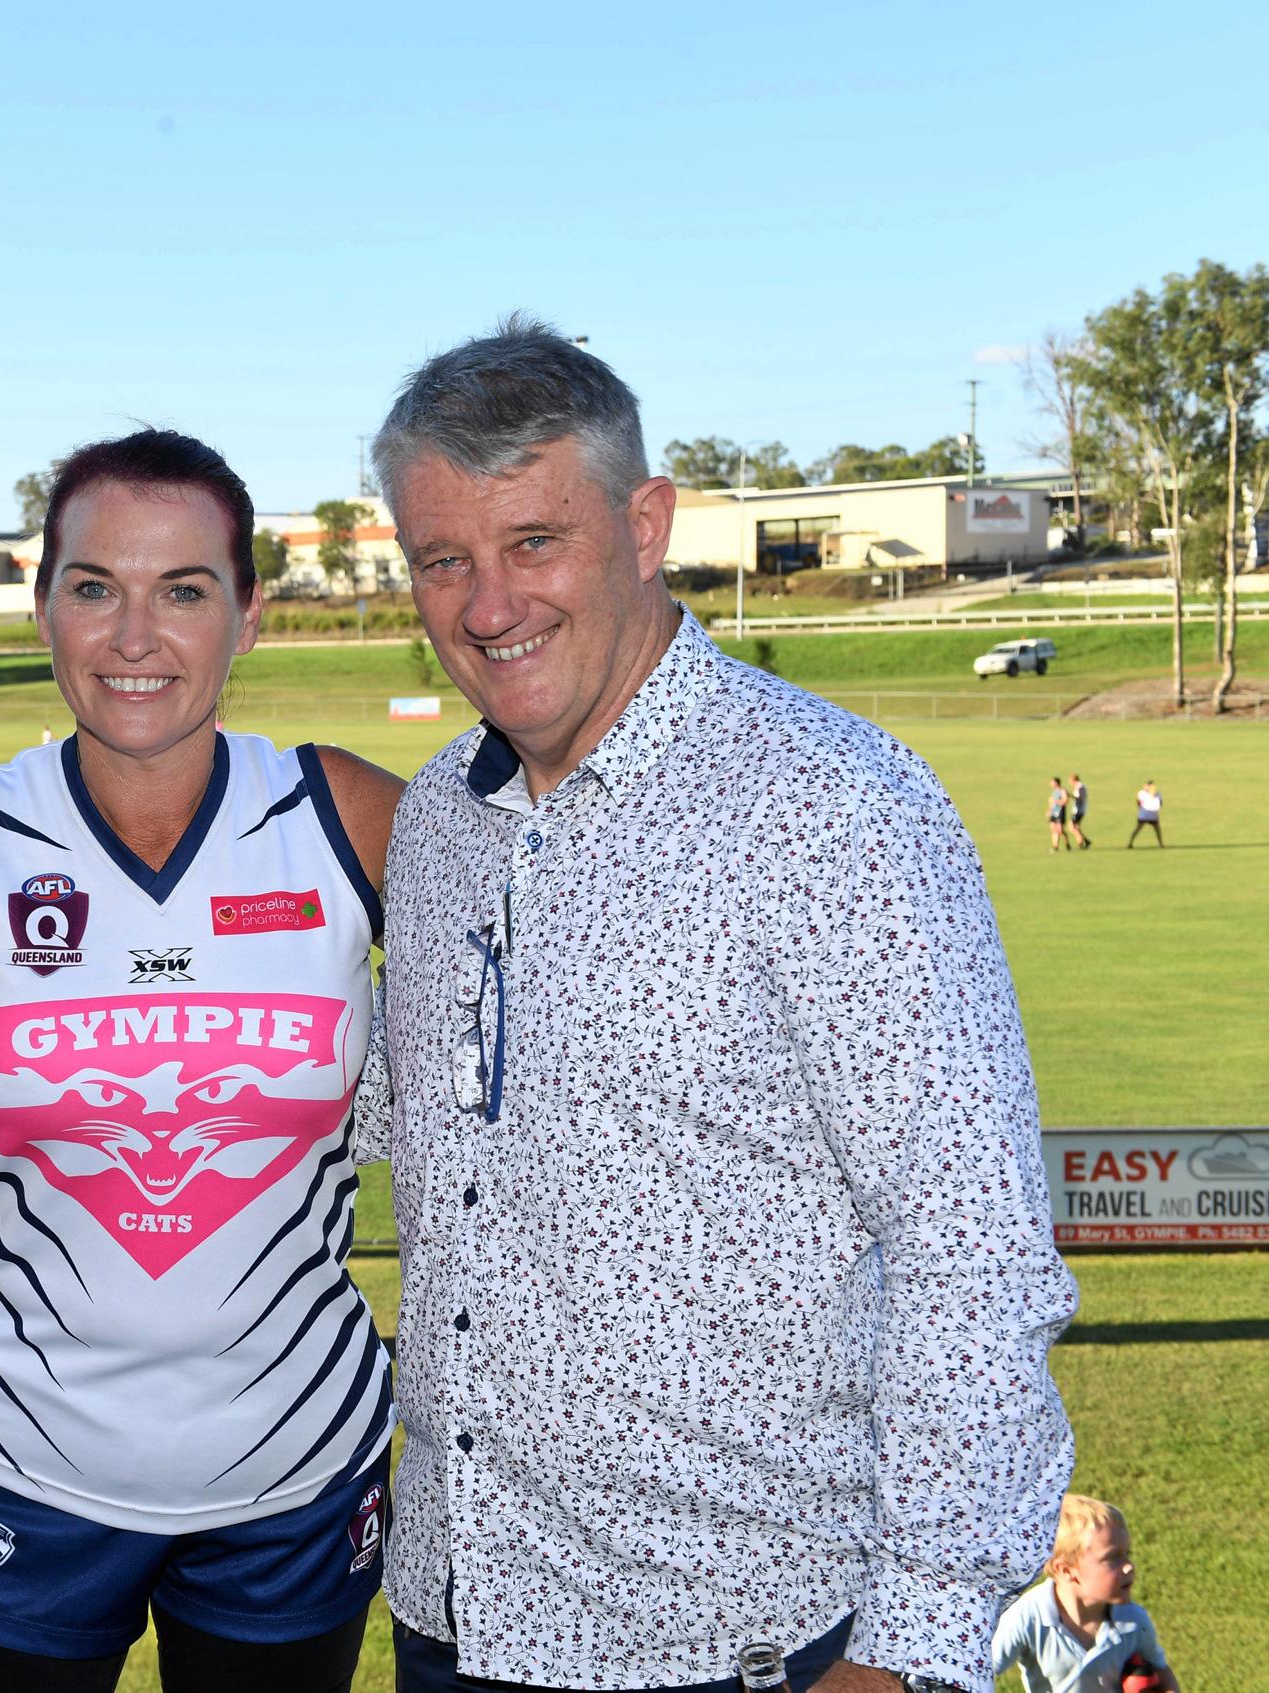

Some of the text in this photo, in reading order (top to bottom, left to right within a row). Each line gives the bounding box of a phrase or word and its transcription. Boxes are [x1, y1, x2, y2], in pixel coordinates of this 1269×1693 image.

[27, 878, 72, 895] AFL
[240, 897, 296, 916] priceline
[25, 905, 70, 948] Q
[242, 913, 300, 928] pharmacy
[11, 951, 82, 964] QUEENSLAND
[131, 958, 192, 973] XSW
[11, 1005, 314, 1059] GYMPIE
[1063, 1150, 1178, 1183] EASY
[1064, 1190, 1269, 1218] TRAVEL AND CRUIS
[118, 1212, 193, 1234] CATS
[1079, 1226, 1111, 1243] Mary
